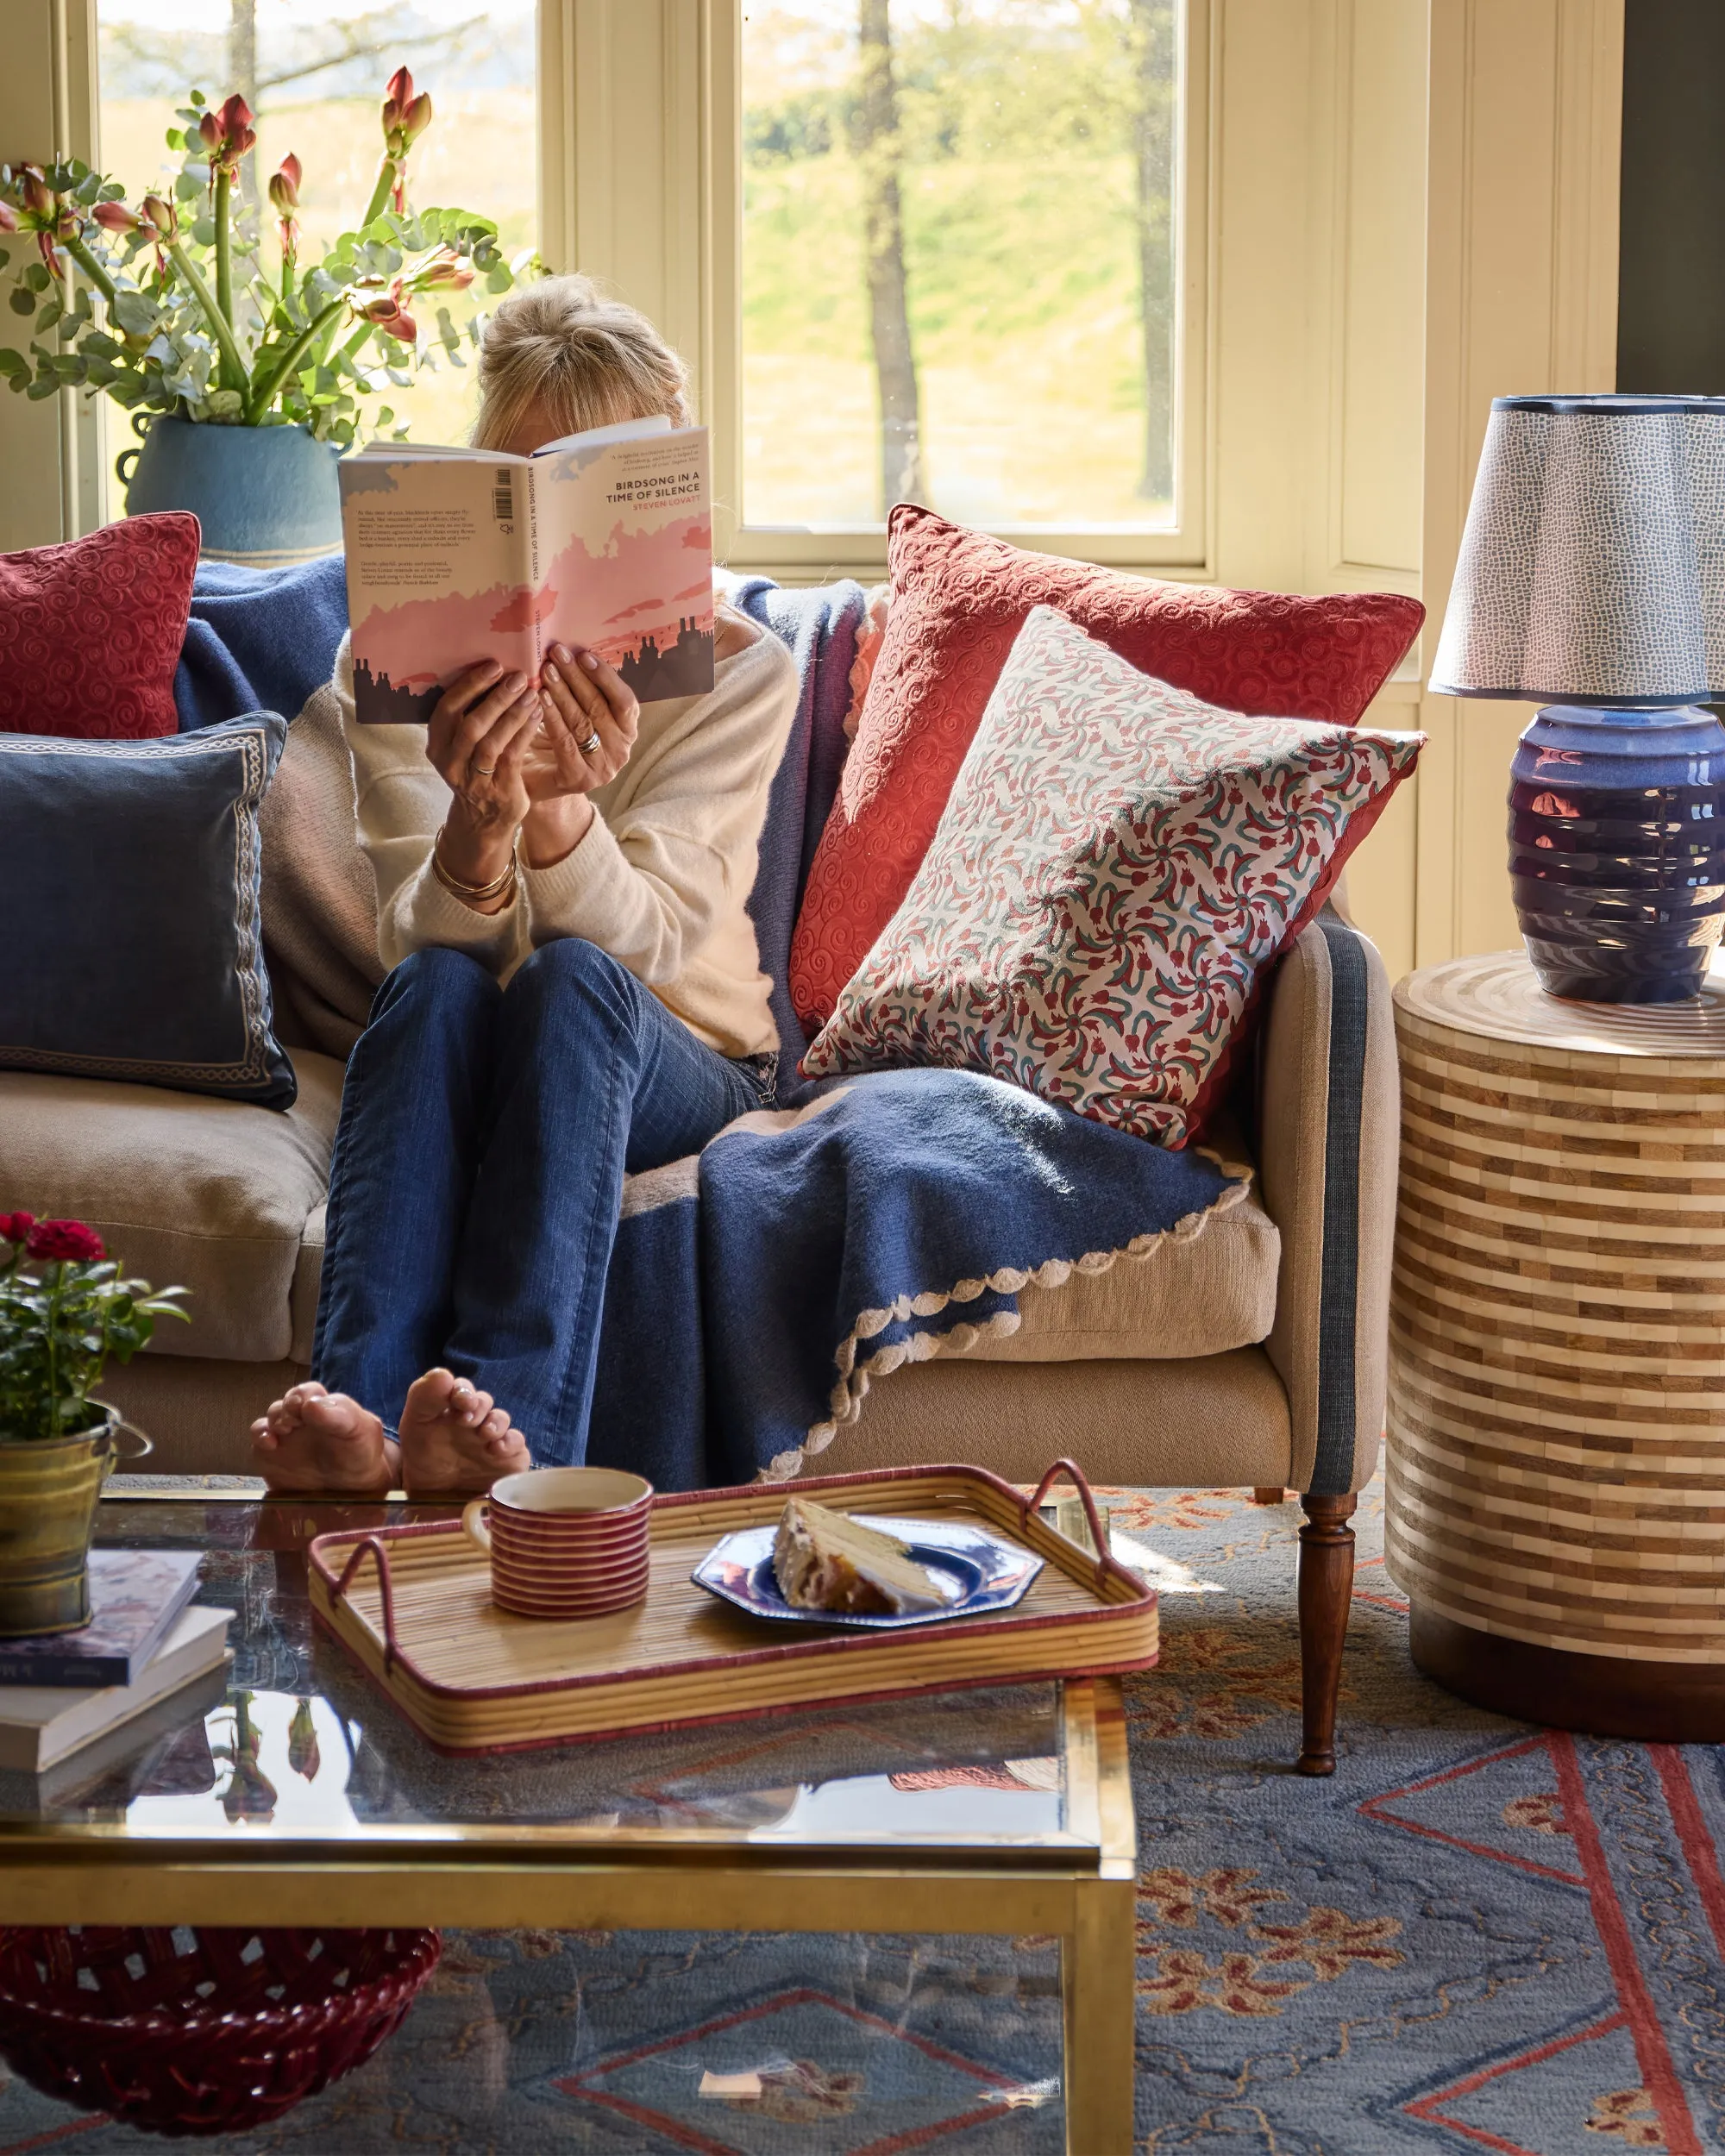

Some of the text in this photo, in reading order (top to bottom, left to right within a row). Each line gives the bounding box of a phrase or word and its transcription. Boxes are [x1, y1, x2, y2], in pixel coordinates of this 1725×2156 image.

[527, 467, 536, 505] BIRDSONG
[616, 471, 699, 491] BIRDSONG IN A
[606, 483, 700, 504] TIME OF SILENCE
[632, 494, 701, 511] STEVEN LOVATT
[530, 505, 536, 514] IN
[531, 540, 537, 549] OF
